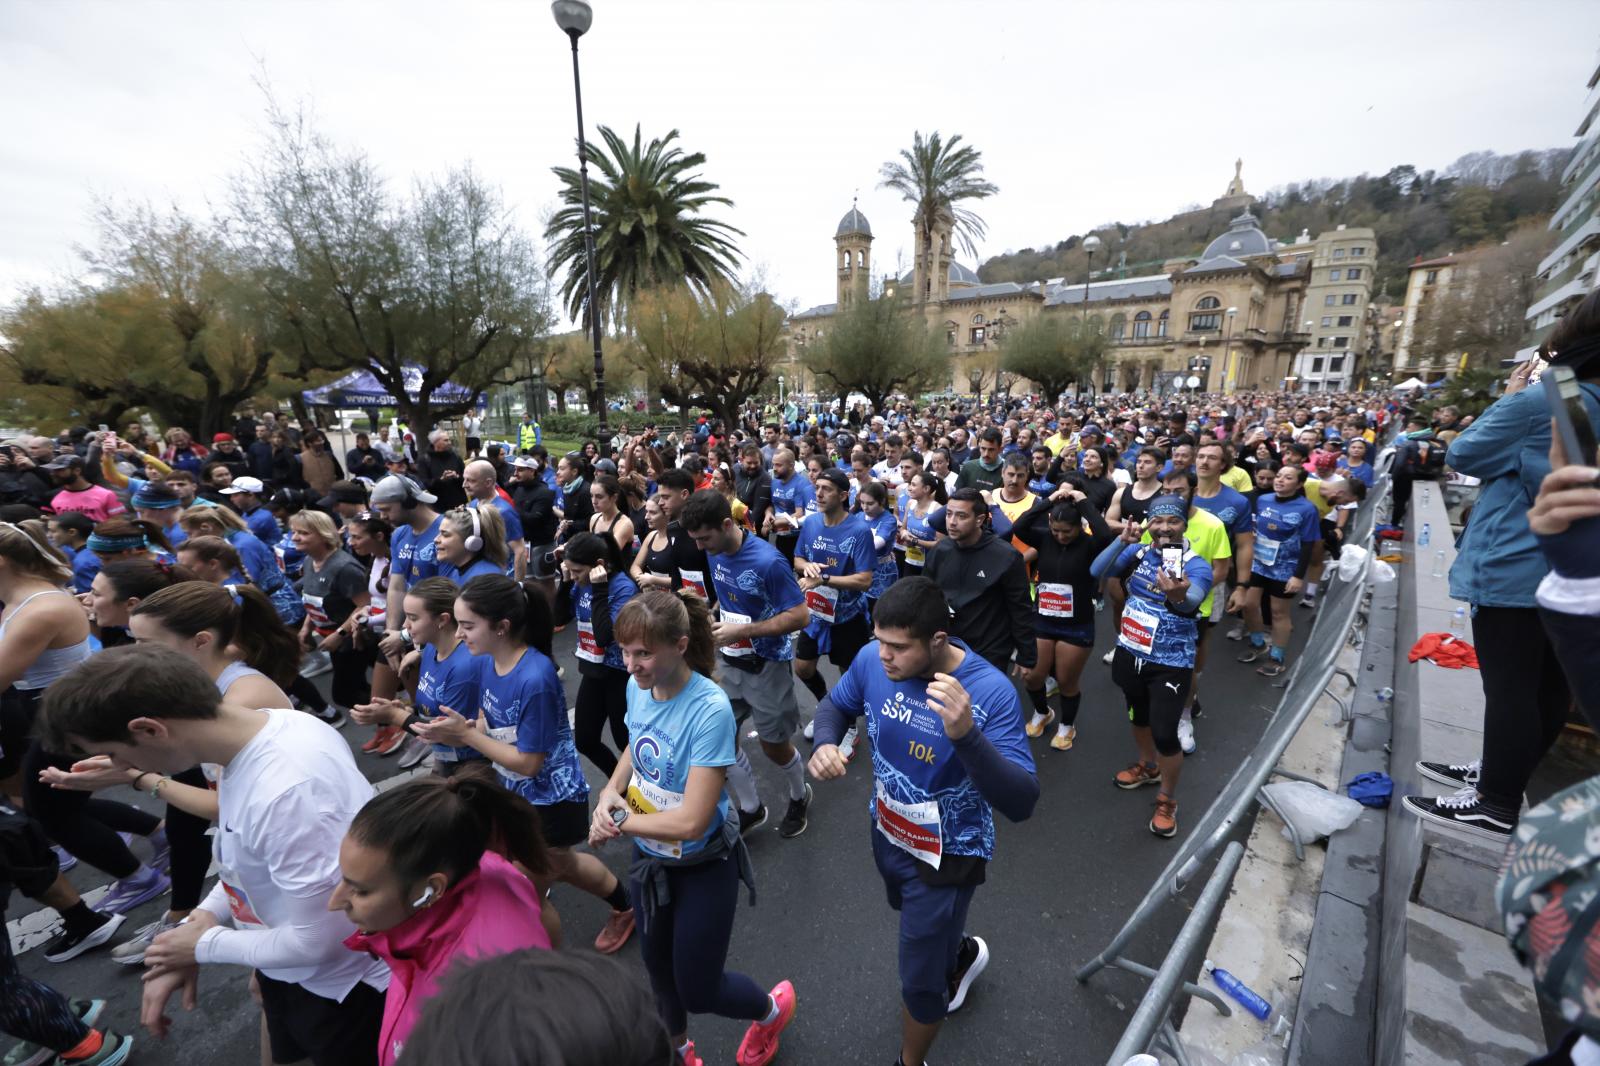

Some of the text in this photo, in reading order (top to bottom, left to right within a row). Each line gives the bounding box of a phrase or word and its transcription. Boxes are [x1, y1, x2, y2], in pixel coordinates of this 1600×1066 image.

[881, 698, 913, 725] SSM
[908, 741, 937, 765] 10k
[641, 784, 668, 806] ZURICH
[890, 803, 926, 819] ZURICH
